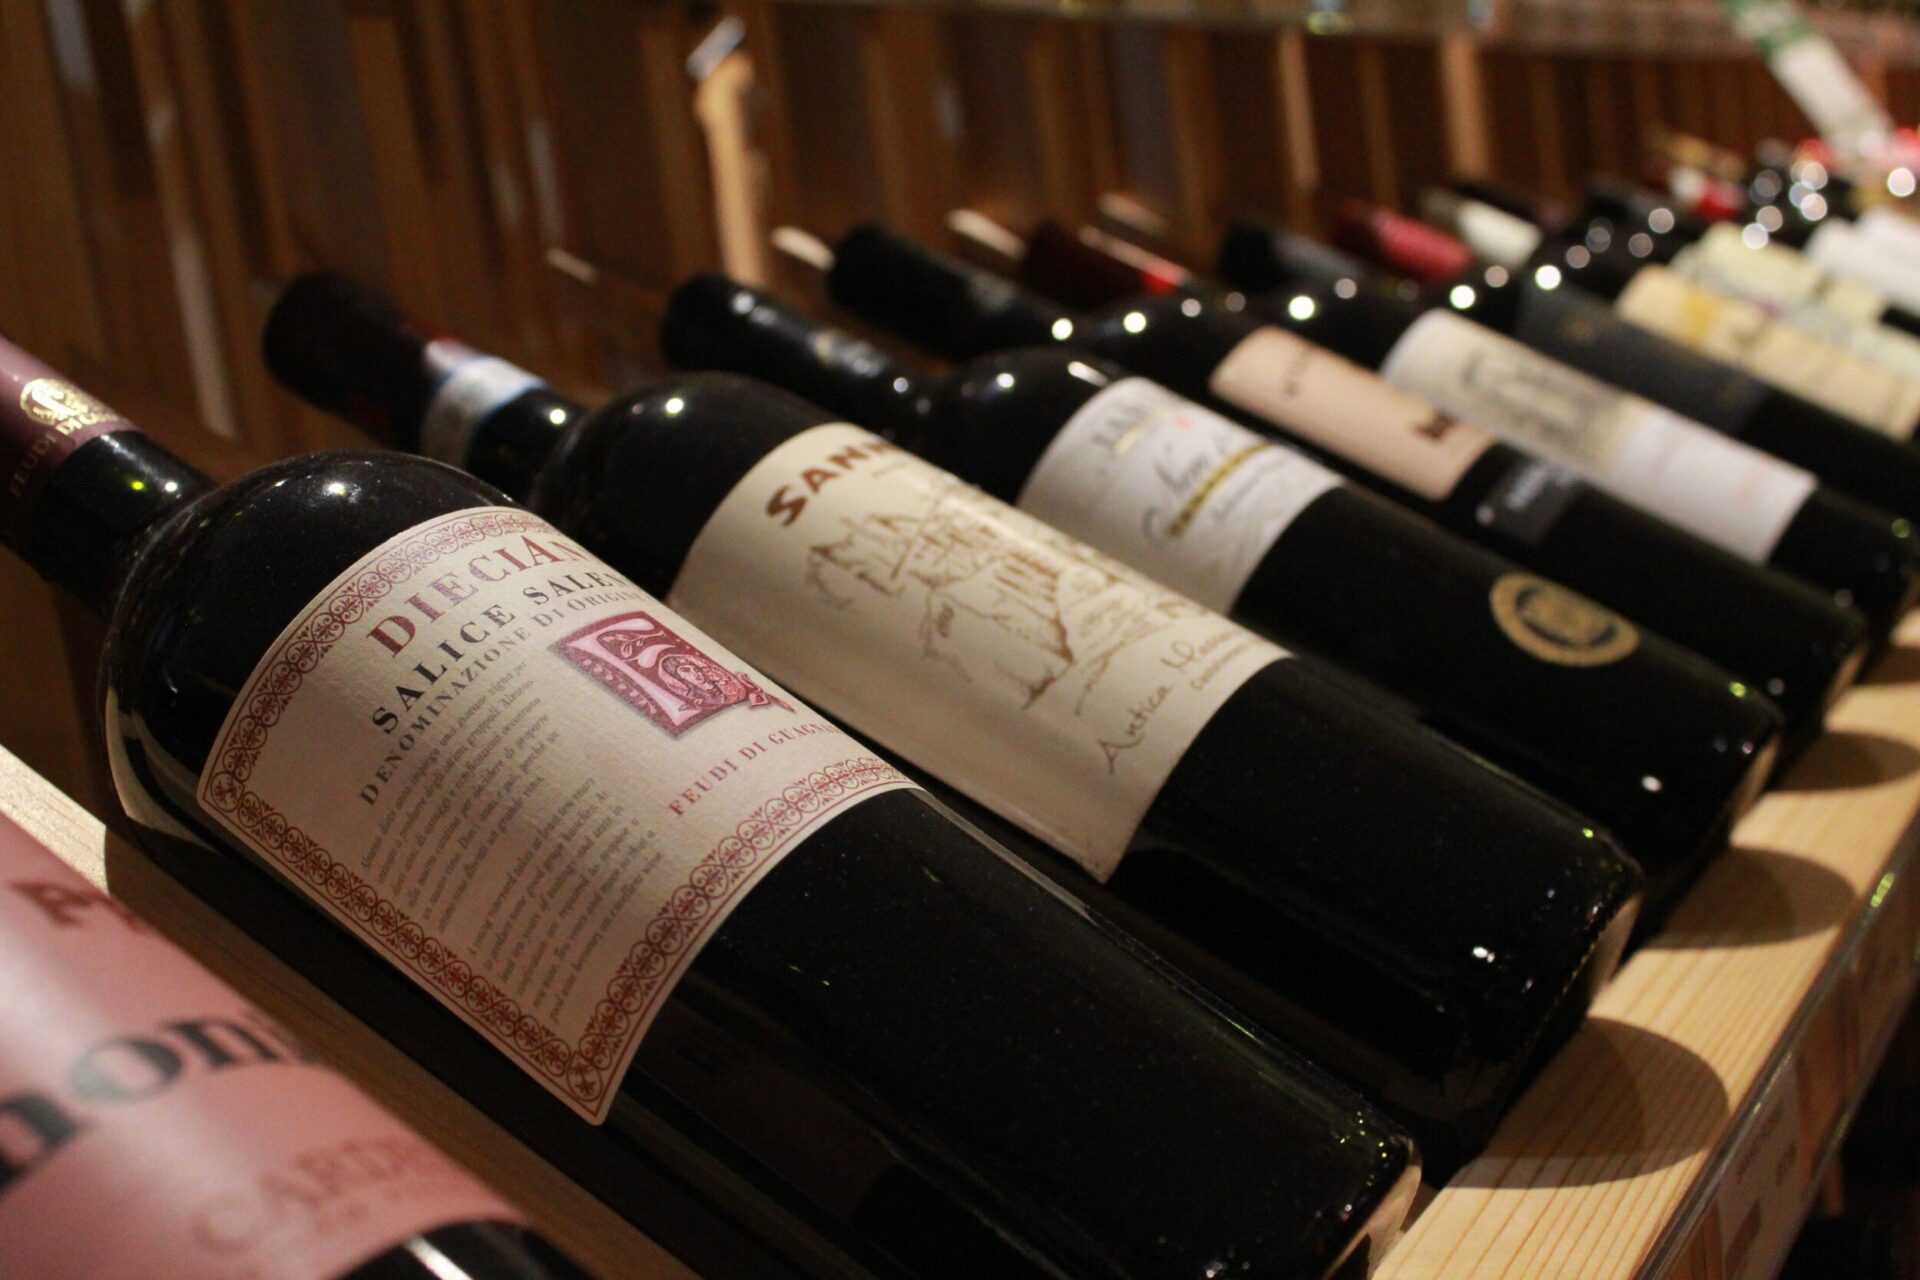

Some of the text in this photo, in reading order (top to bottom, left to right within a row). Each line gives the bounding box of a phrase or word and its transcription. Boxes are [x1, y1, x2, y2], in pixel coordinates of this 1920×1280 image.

[357, 625, 534, 807] DENOMINAZIONE
[372, 604, 517, 735] SALICE
[669, 758, 738, 817] FEUDI
[738, 741, 768, 761] DI
